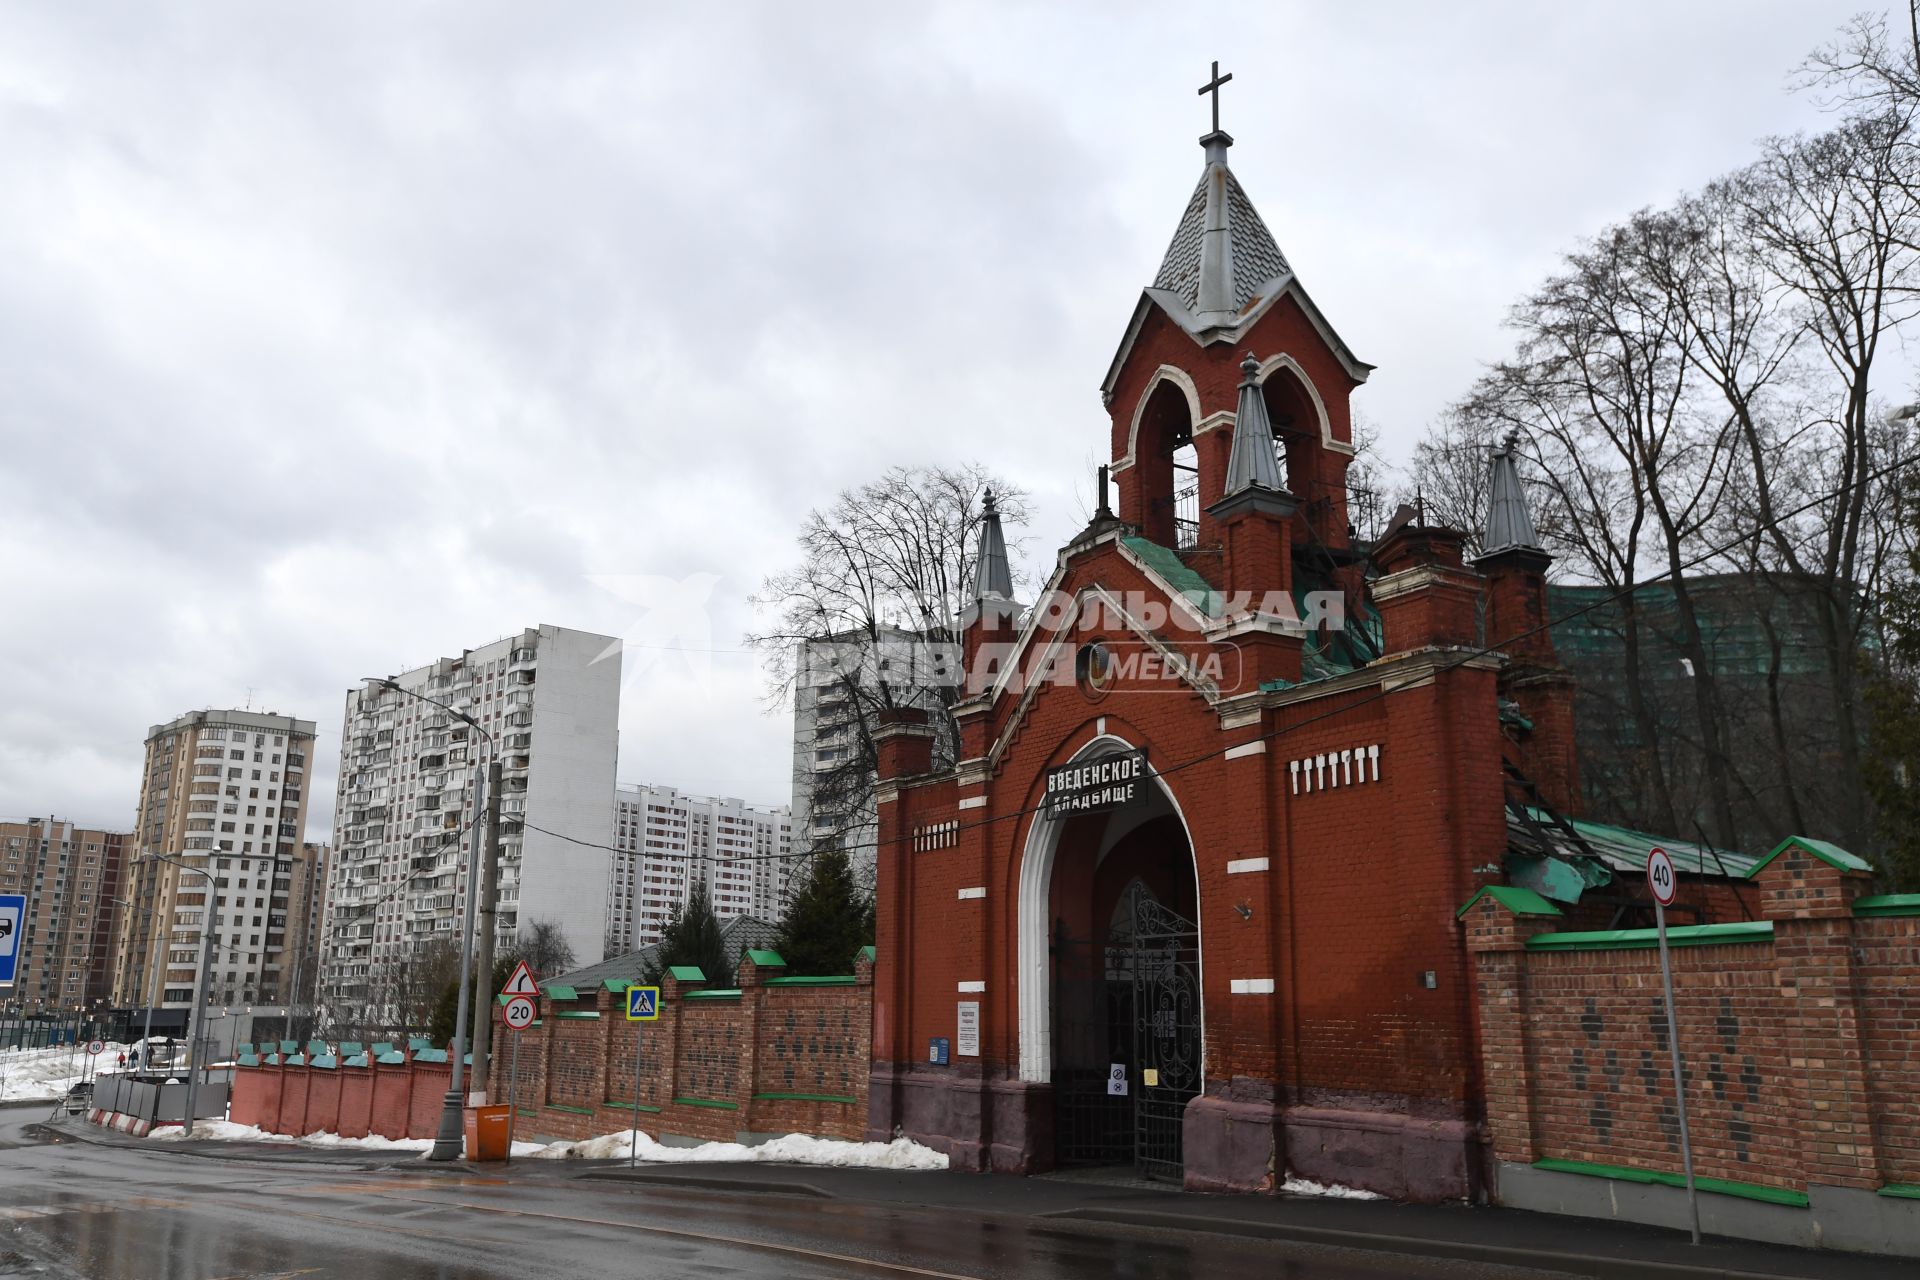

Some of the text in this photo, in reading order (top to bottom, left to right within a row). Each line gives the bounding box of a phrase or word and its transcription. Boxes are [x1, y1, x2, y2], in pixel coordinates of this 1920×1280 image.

[1048, 756, 1141, 793] ВВЕДЕНСКОЕ
[1054, 783, 1135, 812] КЛАДБИЩЕ
[1653, 863, 1670, 887] 40
[510, 1006, 529, 1019] 20
[92, 1043, 101, 1051] 10
